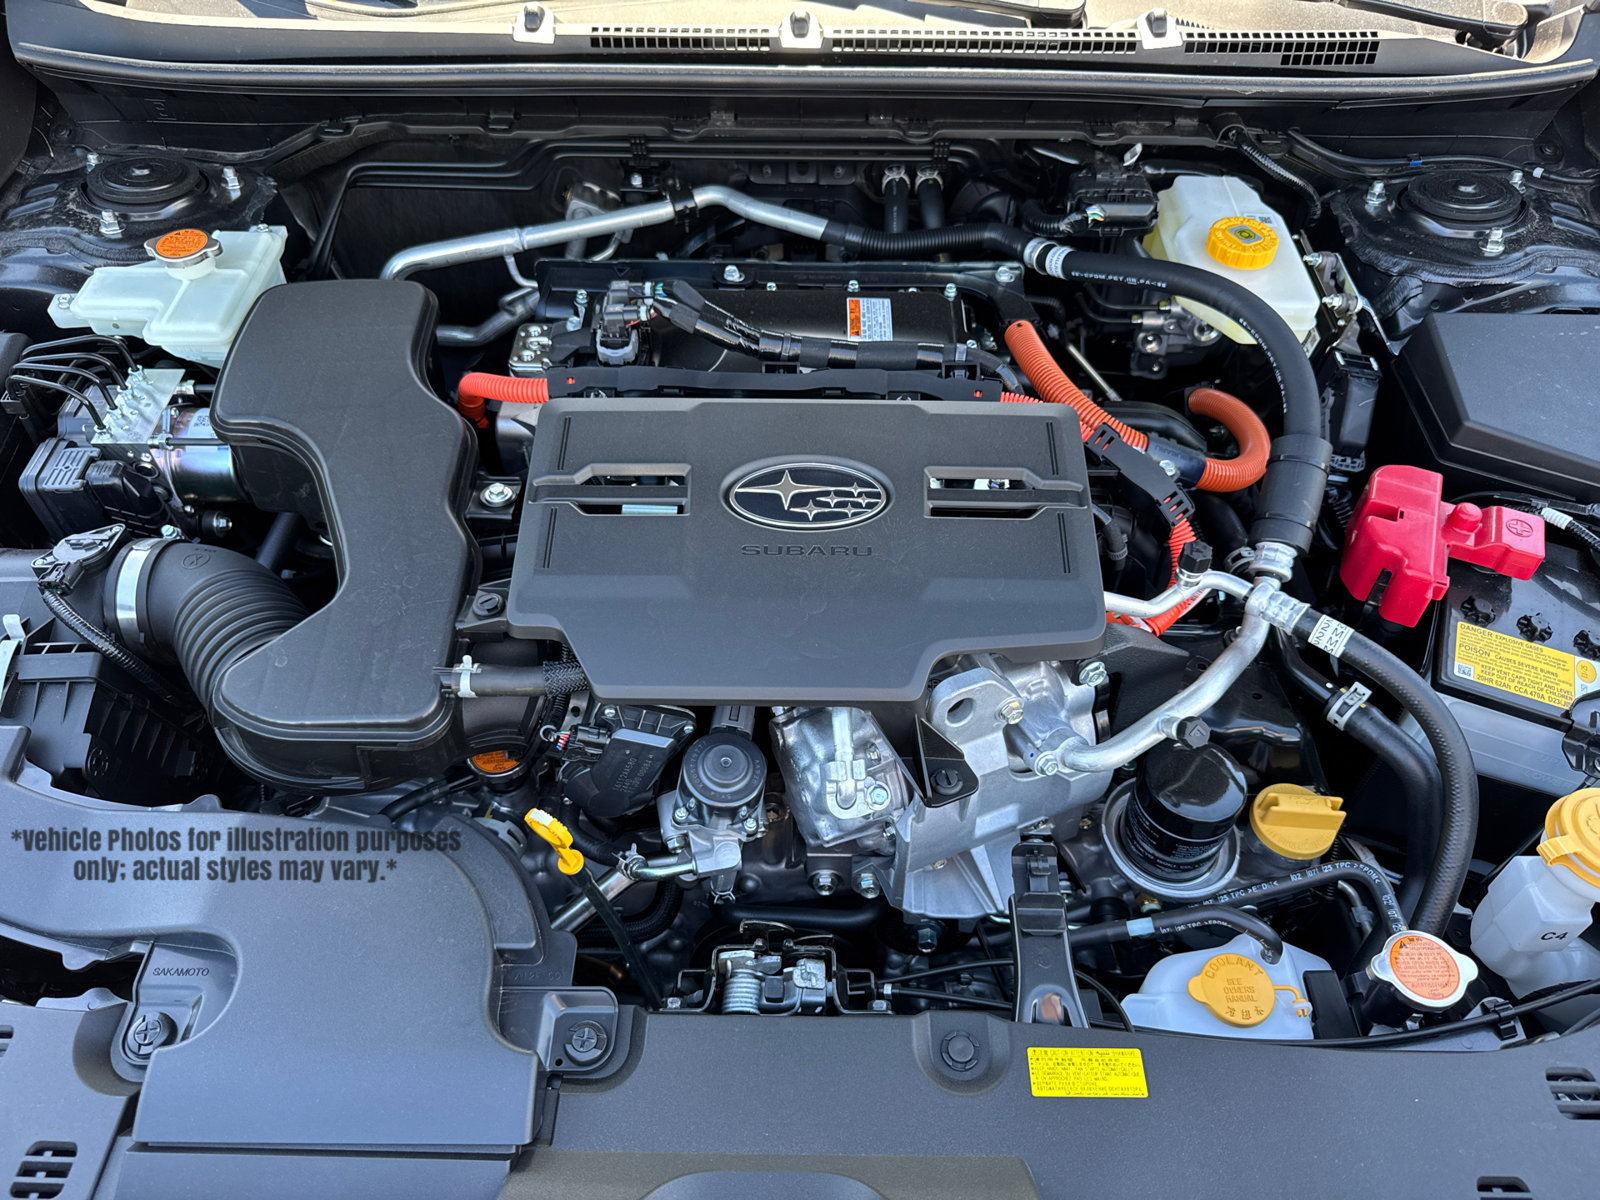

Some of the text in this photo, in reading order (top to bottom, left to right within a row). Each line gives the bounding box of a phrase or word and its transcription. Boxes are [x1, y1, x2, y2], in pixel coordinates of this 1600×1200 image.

[741, 544, 872, 557] SUBARU
[1331, 628, 1344, 639] M
[1460, 623, 1544, 653] DANGER EXPLOSIVE GASES
[1327, 637, 1339, 648] M
[1459, 643, 1558, 678] POISON CAUSES SEVERE BURNS
[1481, 664, 1495, 673] KEEP
[1496, 668, 1510, 678] VENT
[1511, 673, 1526, 682] CAPS
[1527, 678, 1543, 687] TIGHT
[1544, 683, 1555, 692] AND
[1556, 687, 1573, 697] LEVEL
[1481, 669, 1495, 678] KEEP
[1496, 673, 1507, 683] OUT
[1509, 677, 1517, 685] OF
[1517, 680, 1536, 691] REACH
[1537, 686, 1545, 694] OF
[1545, 688, 1573, 701] CHILDREN
[1514, 686, 1529, 695] CCA
[1230, 891, 1245, 900] TPC
[1540, 931, 1568, 941] C4
[153, 966, 210, 977] SAKAMOTO
[1205, 956, 1264, 979] COOLANT
[1225, 994, 1257, 1003] MANUAL
